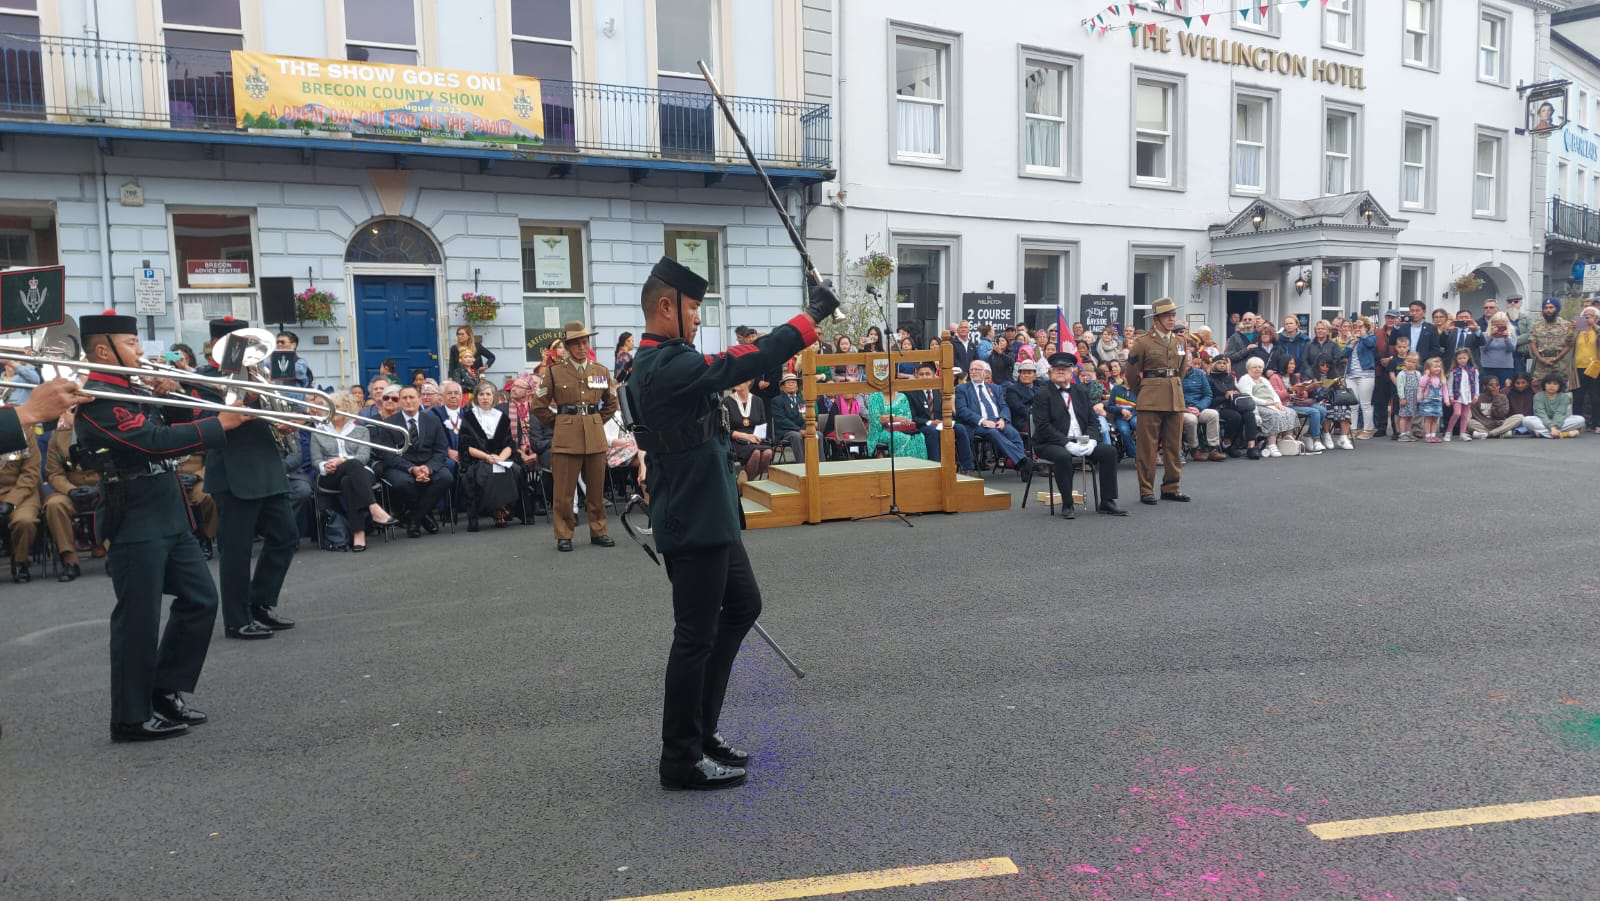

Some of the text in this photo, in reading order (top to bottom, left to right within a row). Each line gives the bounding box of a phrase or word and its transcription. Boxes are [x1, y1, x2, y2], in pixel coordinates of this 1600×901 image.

[1128, 21, 1367, 90] THE WELLINGTON HOTEL
[276, 59, 503, 92] THE SHOW GOES ON!
[302, 81, 485, 107] BRECON COUNTY SHOW
[269, 103, 513, 135] A GREAT DAY OUT FOR ALL THE FAMILY
[967, 308, 1011, 320] 2 COURSE
[527, 331, 553, 349] BRECON
